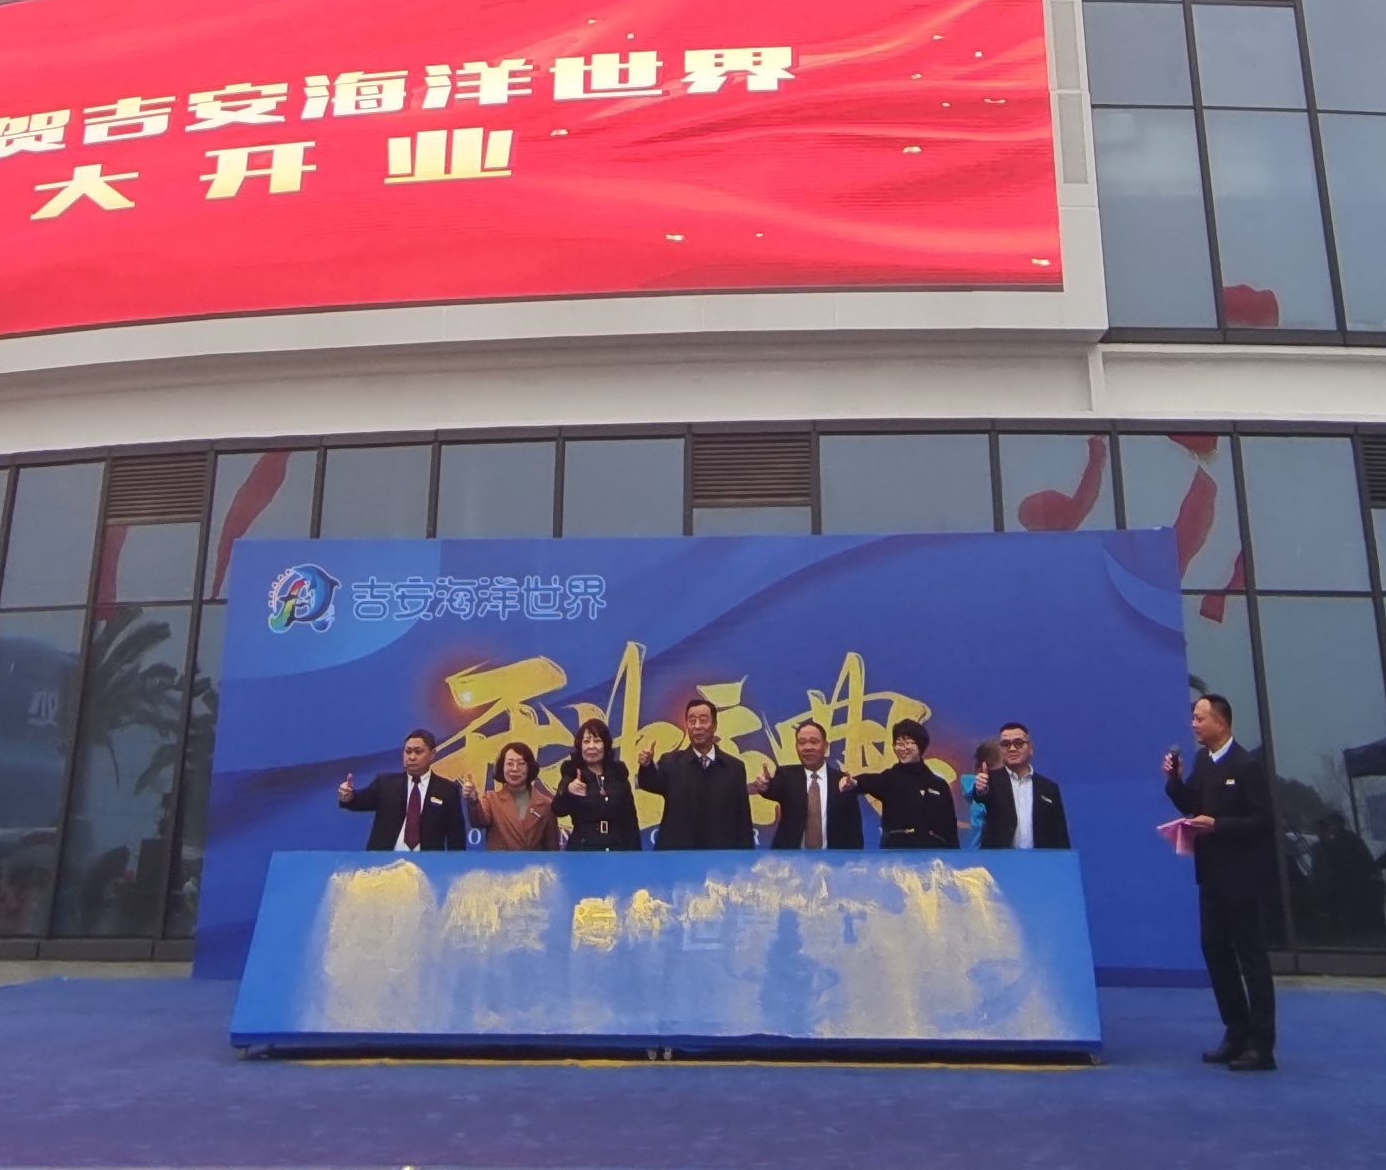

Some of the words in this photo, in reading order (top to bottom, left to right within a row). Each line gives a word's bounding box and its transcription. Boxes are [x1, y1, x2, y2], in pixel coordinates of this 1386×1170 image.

[351, 574, 607, 621] 吉安海洋世界
